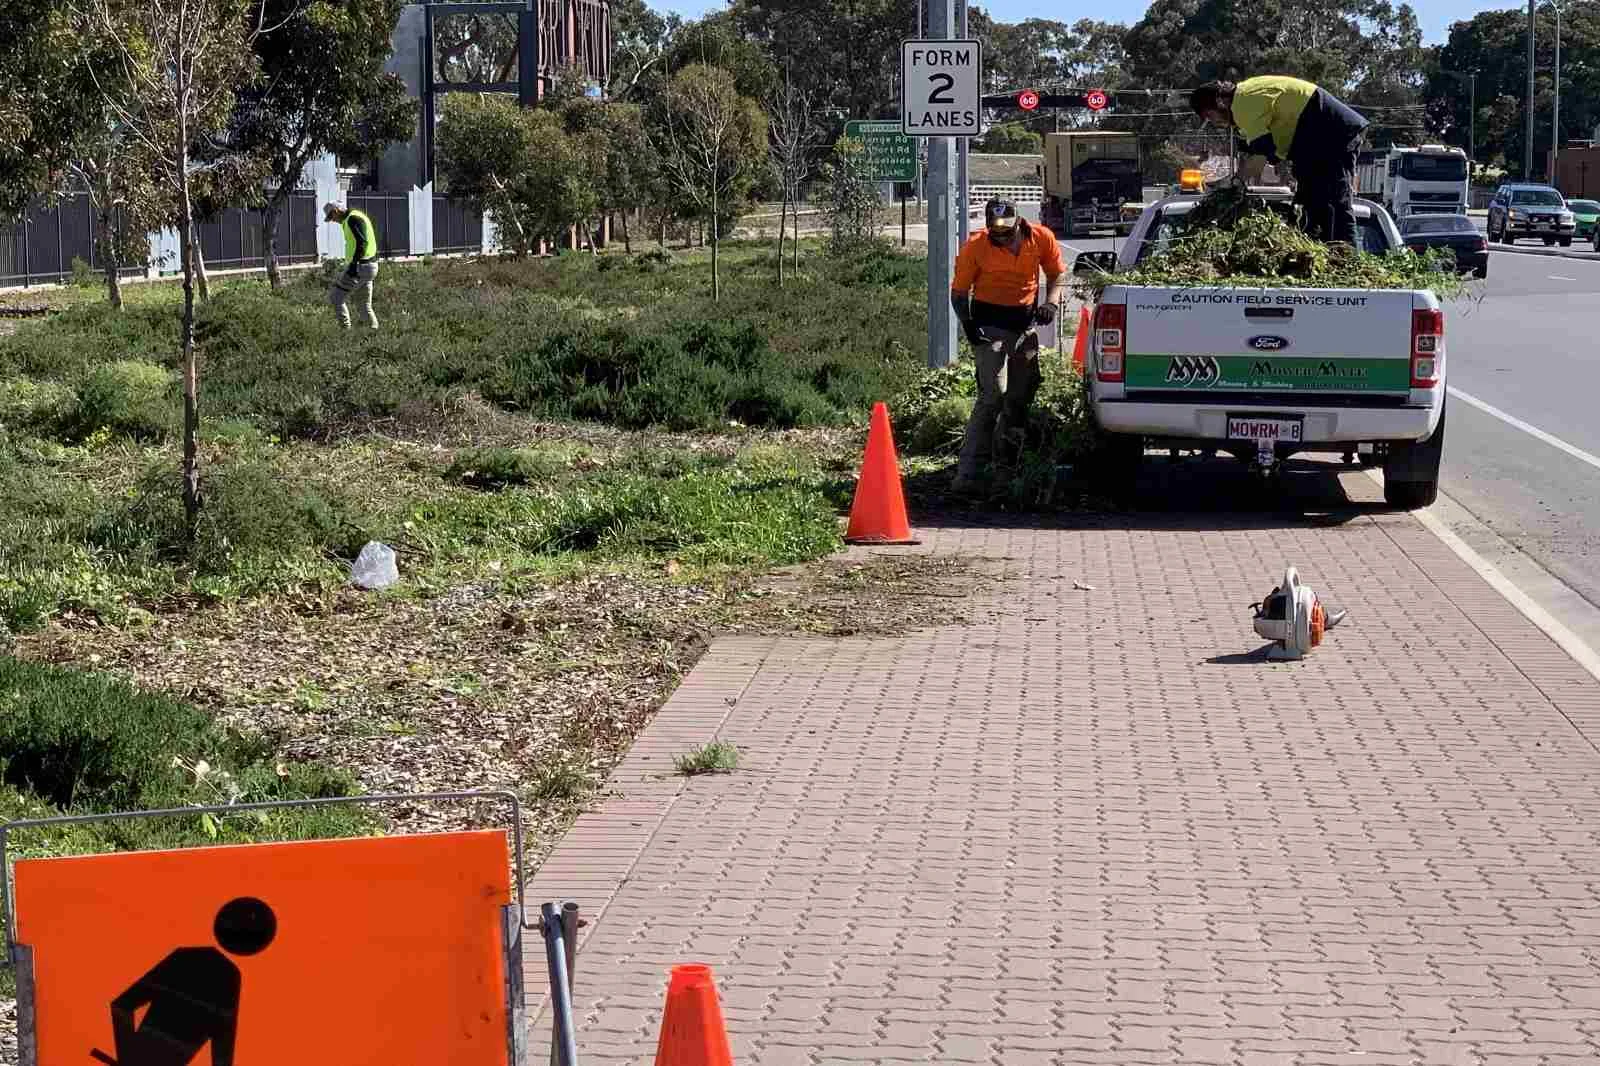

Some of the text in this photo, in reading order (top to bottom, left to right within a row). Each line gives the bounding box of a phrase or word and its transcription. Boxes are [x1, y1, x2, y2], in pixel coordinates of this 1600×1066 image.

[912, 50, 970, 66] FORM
[928, 73, 955, 104] 2
[1091, 96, 1103, 105] 60
[908, 111, 975, 127] LANES
[897, 146, 910, 154] Rd
[1171, 294, 1368, 306] CAUTION FIELD SERVICE UNIT
[1255, 337, 1281, 349] Ford
[1230, 422, 1279, 438] MOWRM
